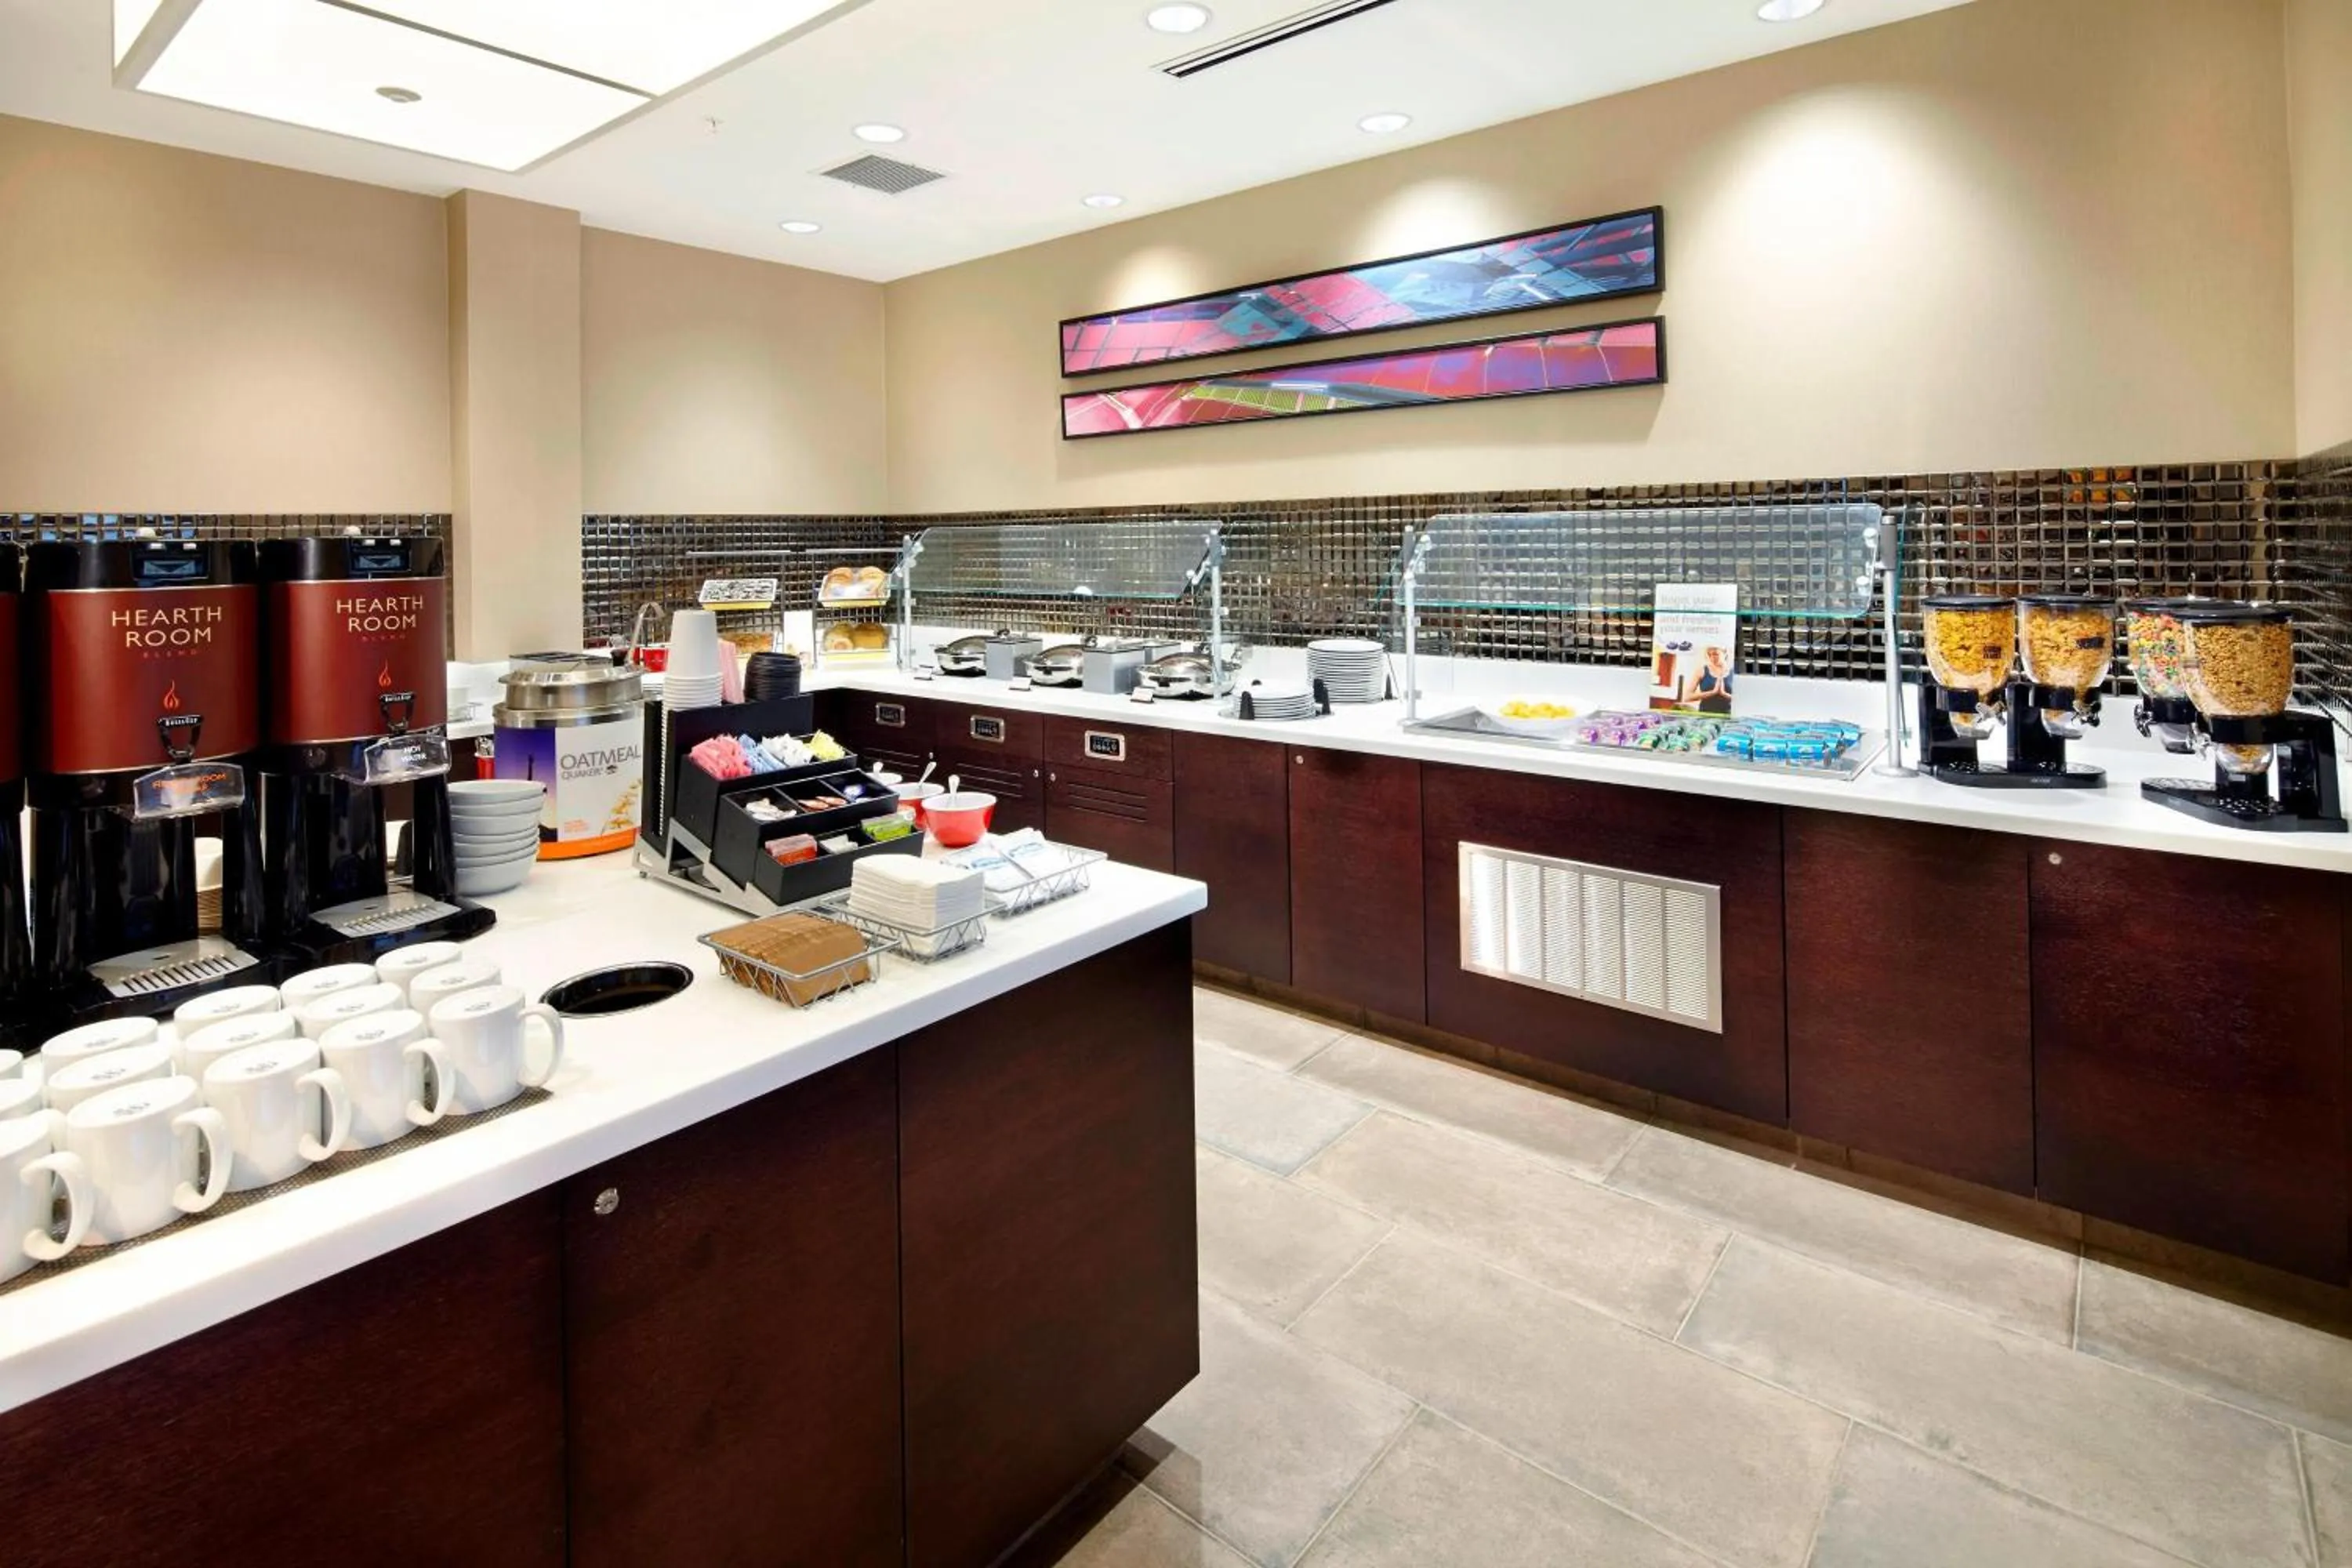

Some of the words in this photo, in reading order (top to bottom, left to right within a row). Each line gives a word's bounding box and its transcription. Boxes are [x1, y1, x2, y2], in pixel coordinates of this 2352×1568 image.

[336, 595, 423, 614] HEARTH
[112, 606, 222, 626] HEARTH
[348, 614, 416, 633] ROOM
[126, 626, 211, 648] ROOM
[560, 745, 641, 771] OATMEAL
